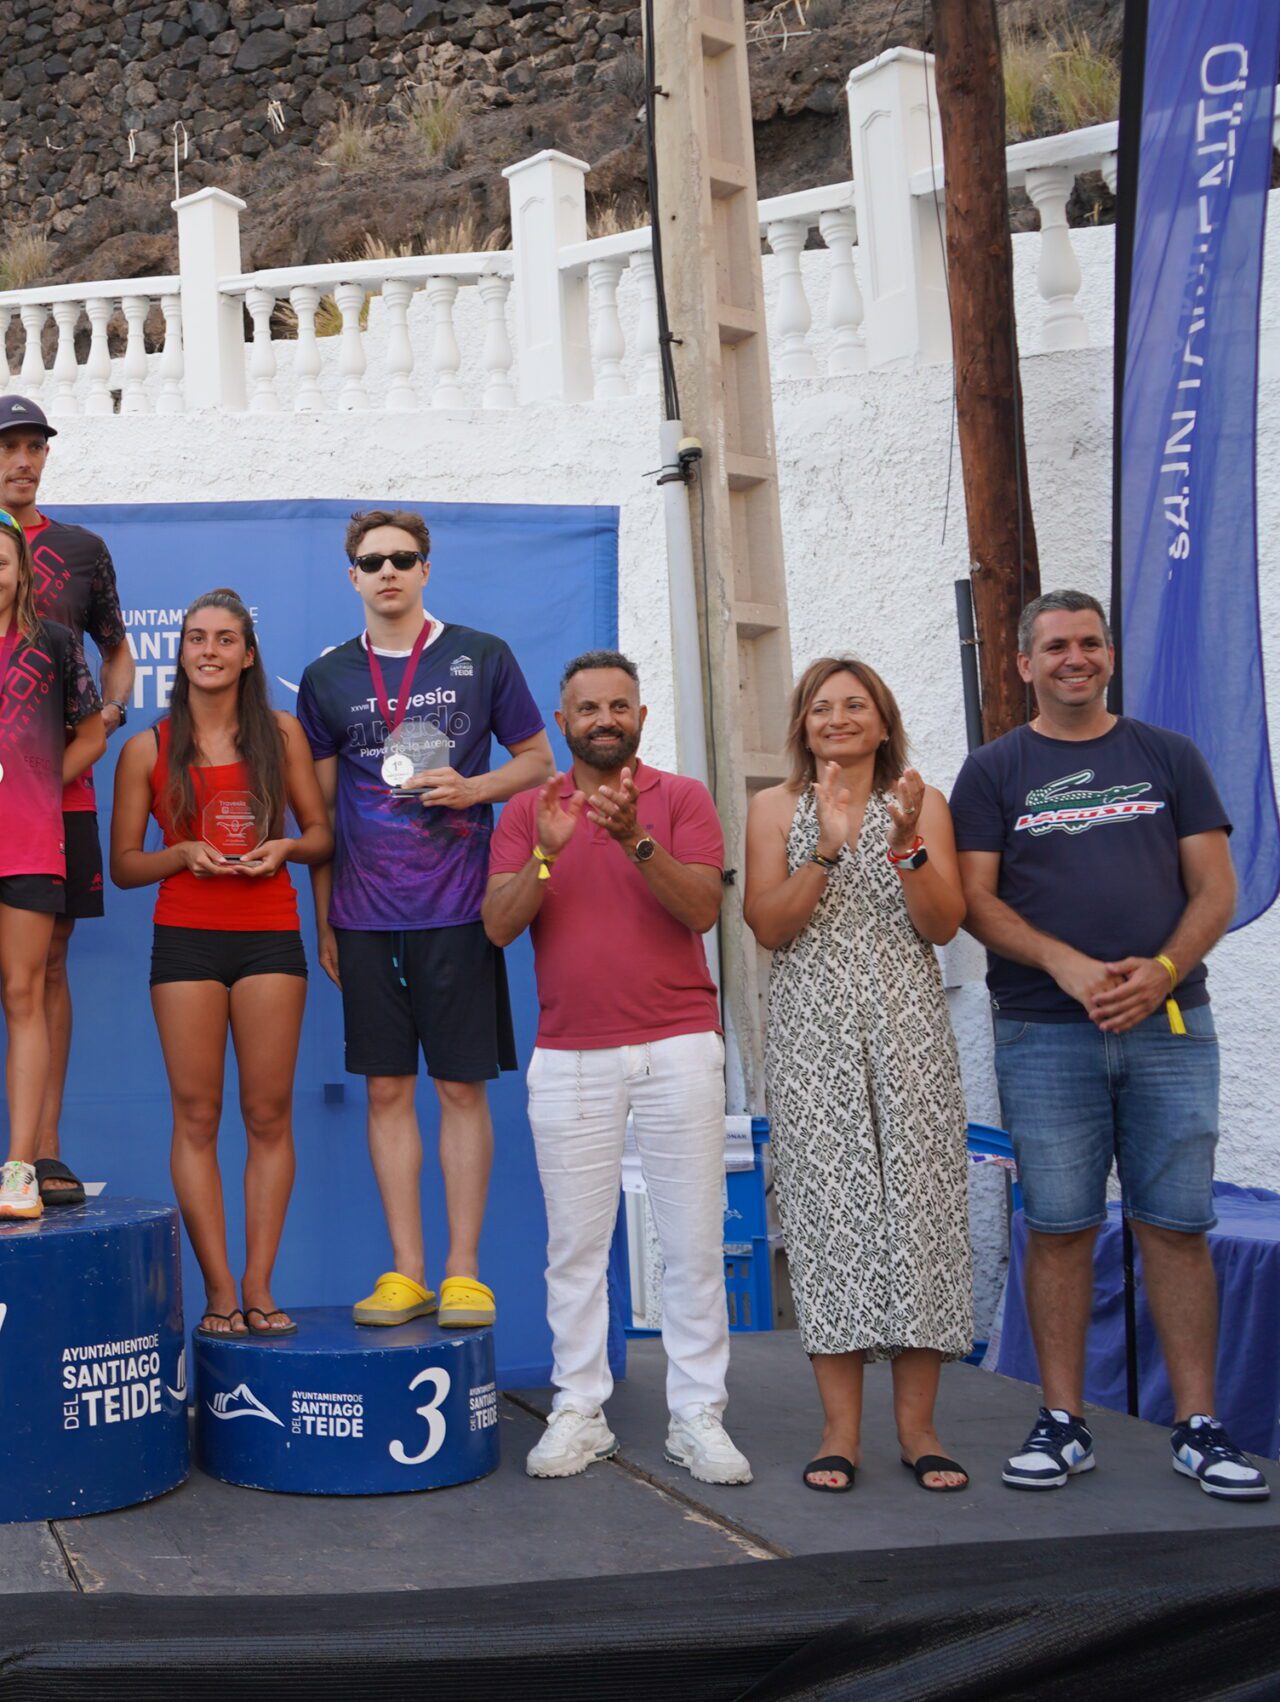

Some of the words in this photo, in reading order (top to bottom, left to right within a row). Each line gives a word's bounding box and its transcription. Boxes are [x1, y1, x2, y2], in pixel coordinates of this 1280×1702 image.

[1015, 801, 1165, 831] LACOSTE
[62, 1351, 160, 1389] SANTIAGO
[64, 1393, 79, 1429] DEL
[81, 1378, 162, 1426] TEIDE
[292, 1400, 364, 1417] SANTIAGO
[389, 1367, 451, 1465] 3
[292, 1415, 301, 1434] DEL
[302, 1415, 363, 1438] TEIDE
